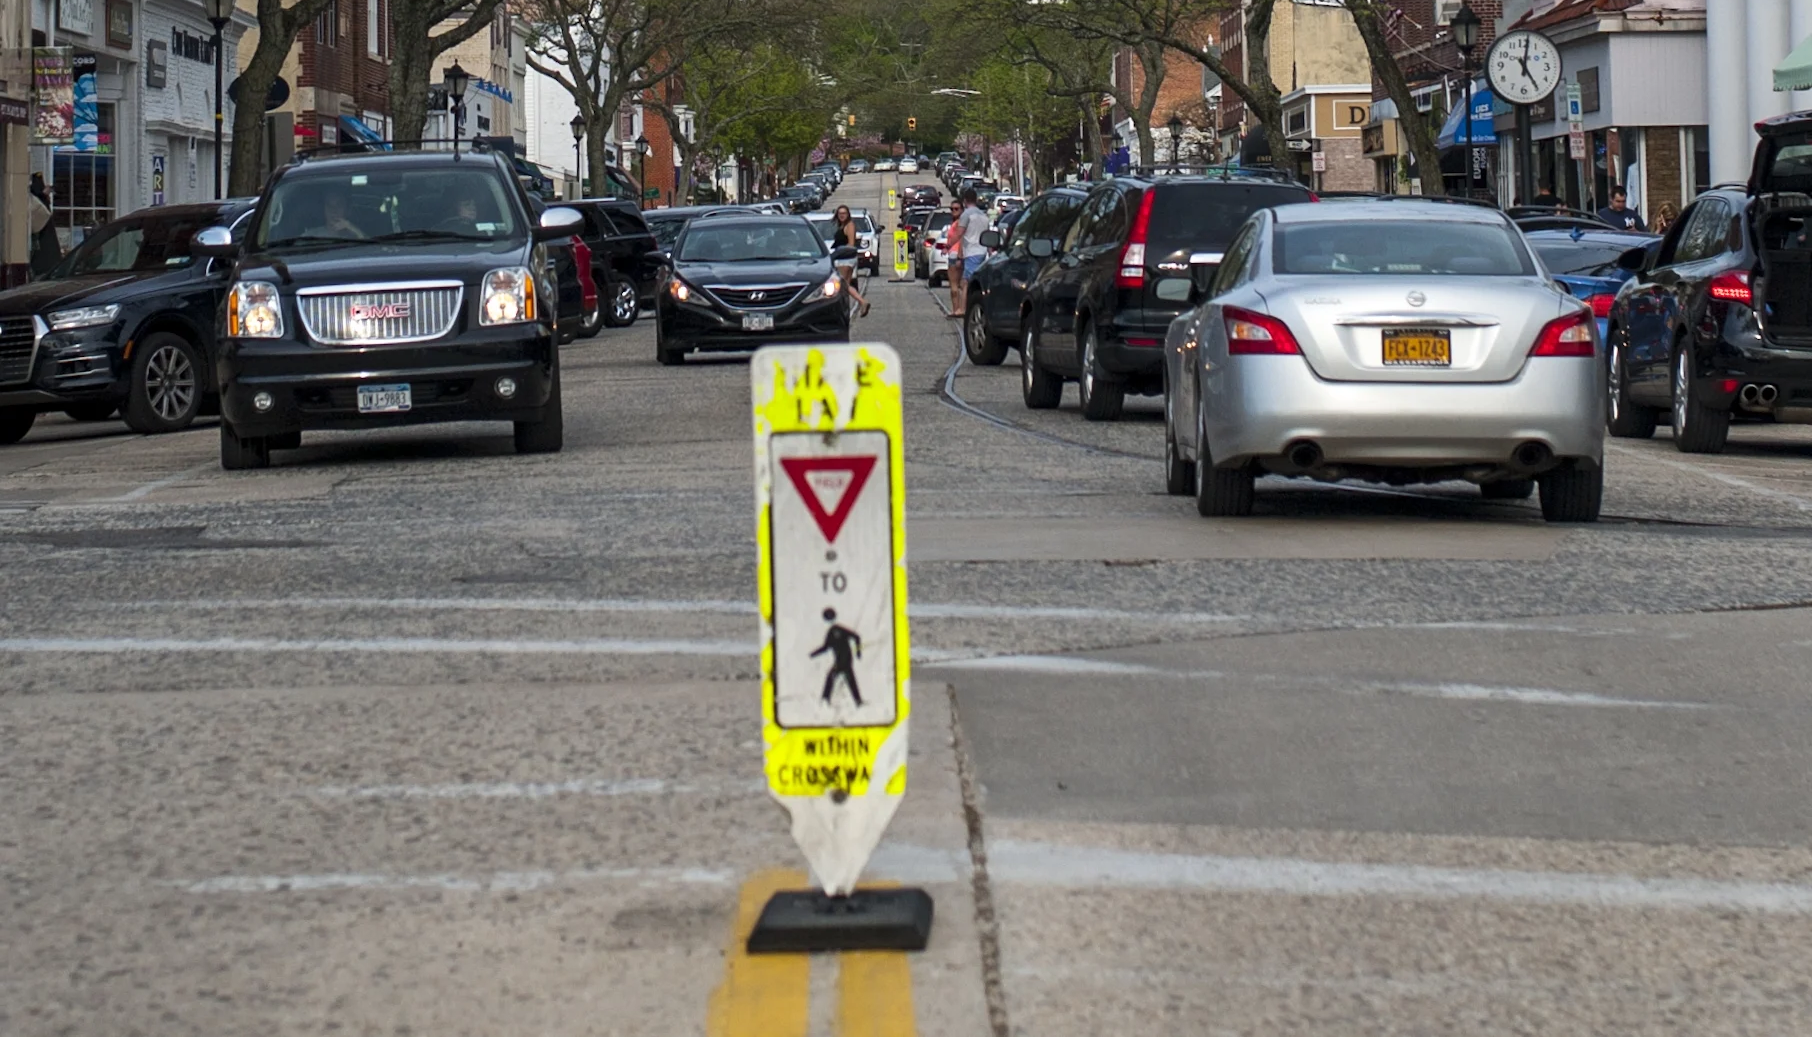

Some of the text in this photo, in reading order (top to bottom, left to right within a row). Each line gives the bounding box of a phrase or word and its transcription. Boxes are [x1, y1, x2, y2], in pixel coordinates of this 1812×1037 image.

[1499, 51, 1509, 59] 10
[1541, 51, 1548, 59] 2
[1497, 61, 1504, 71] 9
[1543, 62, 1551, 72] 3
[1520, 84, 1527, 95] 6
[153, 157, 163, 205] ART
[350, 304, 410, 320] GMC
[819, 570, 848, 594] TO
[804, 737, 869, 756] WITHIN
